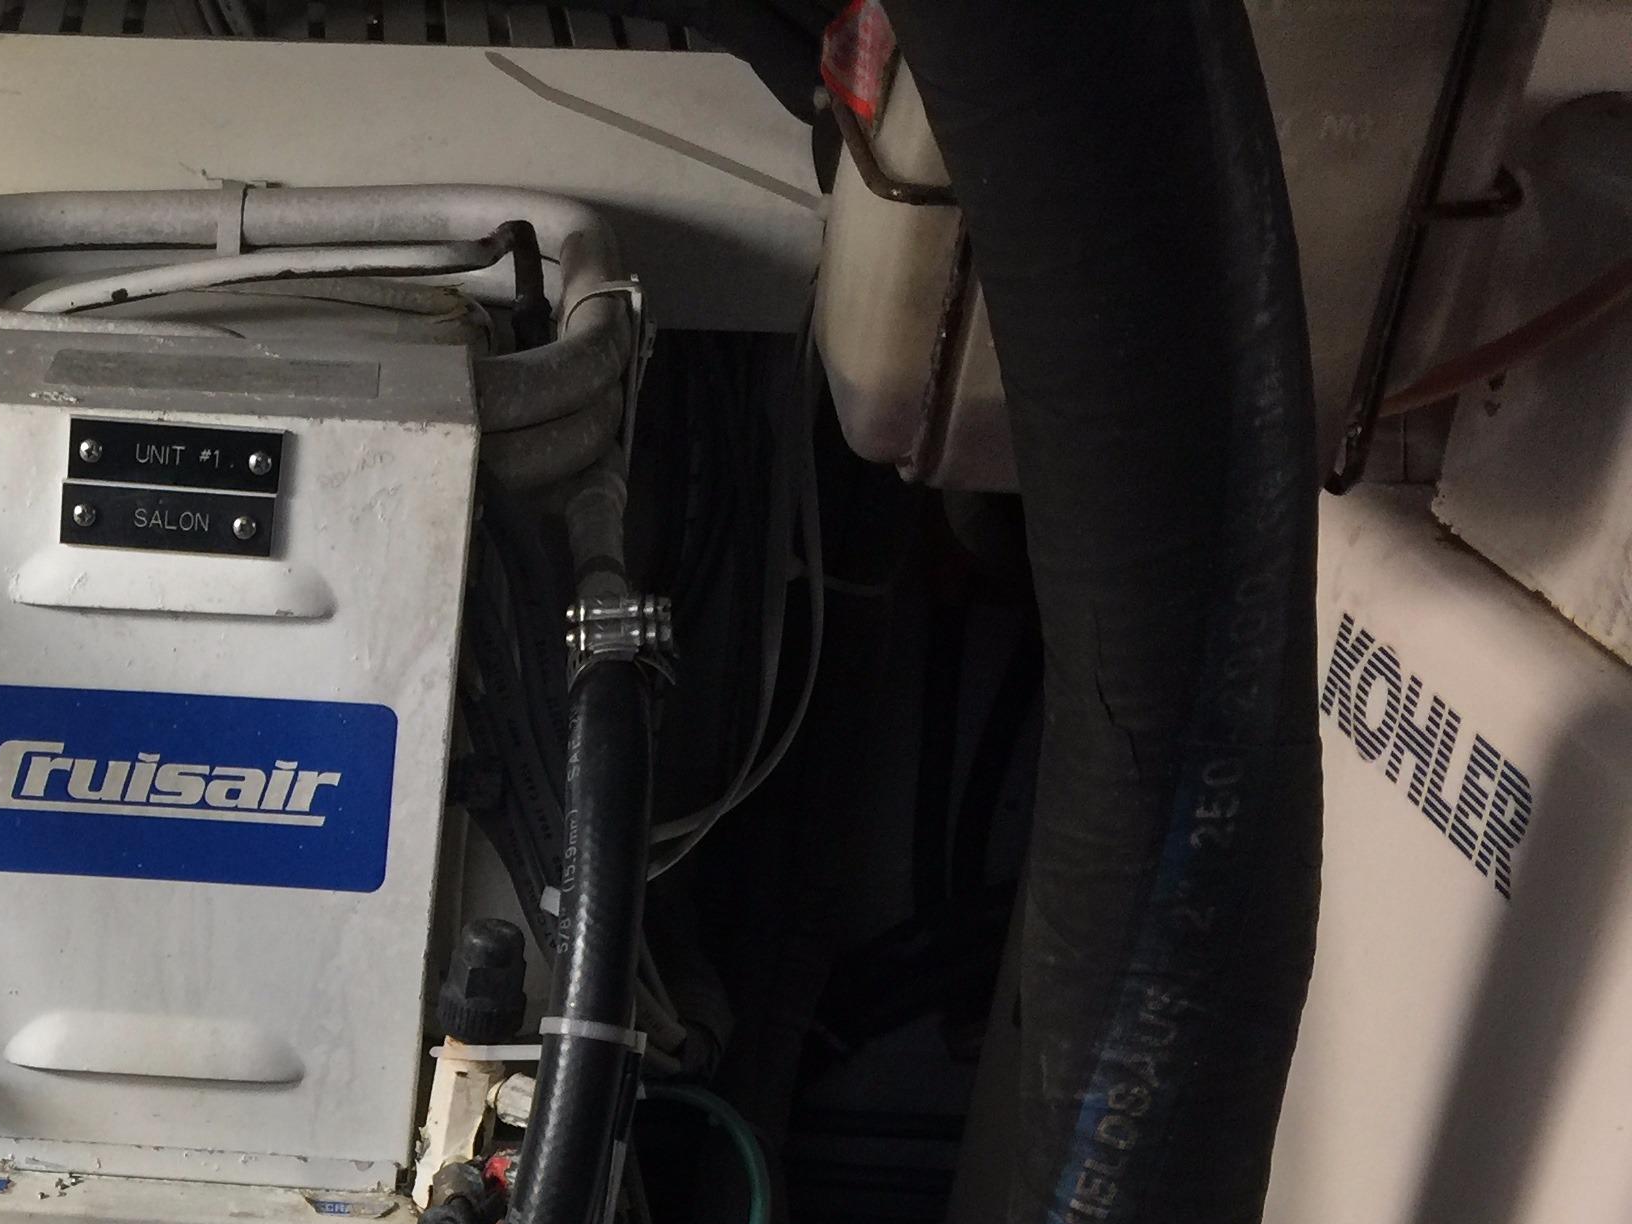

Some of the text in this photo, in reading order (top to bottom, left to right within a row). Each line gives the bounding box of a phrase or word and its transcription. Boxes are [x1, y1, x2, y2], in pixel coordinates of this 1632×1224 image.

[135, 443, 221, 469] UNIT #1
[134, 508, 210, 533] SALON
[1320, 613, 1533, 899] KOHLER
